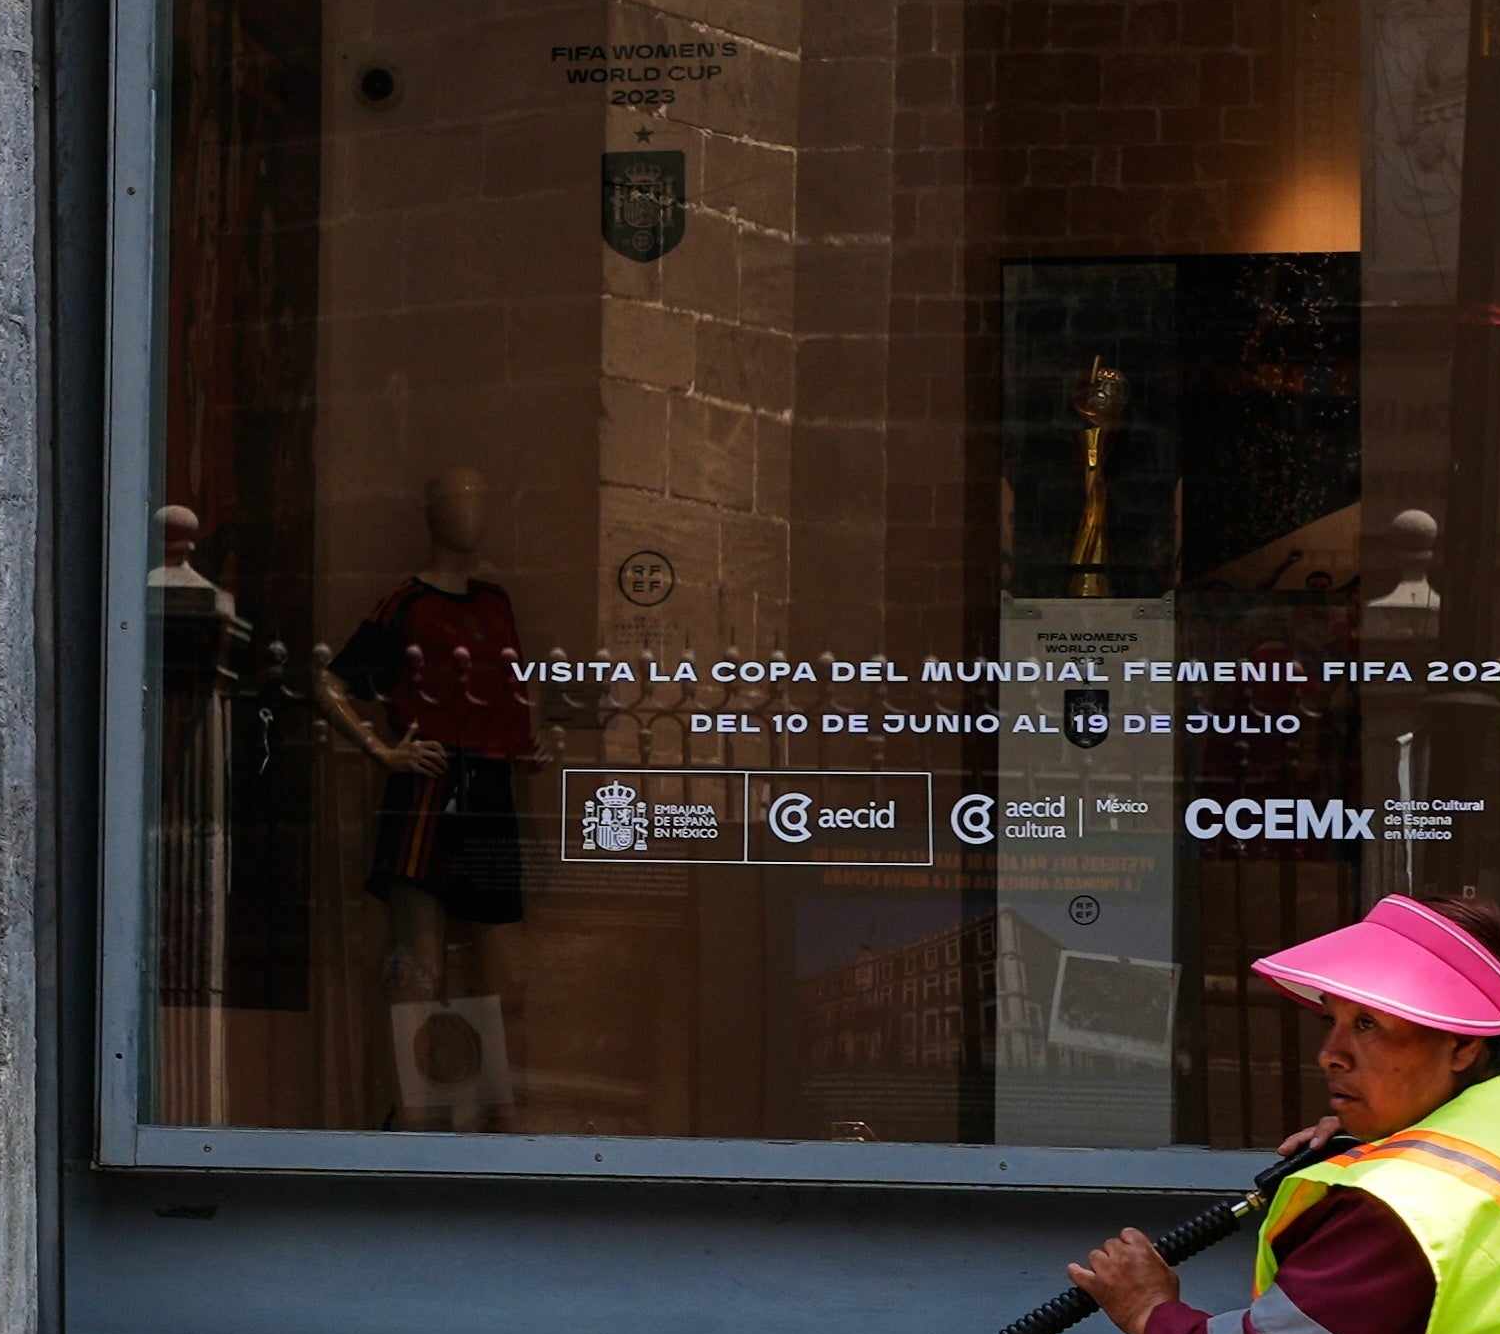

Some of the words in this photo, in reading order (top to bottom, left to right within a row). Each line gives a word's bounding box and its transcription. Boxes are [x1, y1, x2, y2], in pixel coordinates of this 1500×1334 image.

[551, 45, 608, 61] FIFA
[612, 41, 738, 60] WOMEN'S
[566, 66, 661, 84] WORLD
[668, 65, 723, 82] CUP
[610, 89, 677, 105] 2023
[1037, 633, 1068, 642] FIFA
[1069, 632, 1139, 643] WOMEN'S
[1045, 645, 1097, 654] WORLD
[1099, 644, 1130, 654] CUP
[510, 661, 636, 683] VISITA
[648, 661, 698, 683] LA
[711, 661, 818, 683] COPA
[831, 661, 909, 683] DEL
[921, 661, 1109, 683] MUNDIAL
[1123, 661, 1308, 683] FEMENIL
[1323, 661, 1413, 682] FIFA
[690, 713, 761, 734] DEL
[772, 713, 808, 734] 10
[821, 713, 870, 734] DE
[881, 713, 1000, 734] JUNIO
[1012, 714, 1060, 734] AL
[1072, 714, 1110, 734] 19
[1123, 714, 1172, 734] DE
[1185, 714, 1301, 734] JULIO
[653, 803, 716, 817] EMBAJADA
[1005, 796, 1066, 818] aecid
[1096, 797, 1149, 814] México
[1383, 799, 1430, 811] Centro
[1431, 799, 1485, 811] Cultural
[653, 815, 673, 827] DE
[817, 800, 896, 830] aecid
[1184, 798, 1376, 841] CCEMx
[1383, 814, 1402, 826] de
[653, 826, 670, 839] EN
[671, 825, 720, 840] MÉXICO
[1004, 817, 1068, 840] cultura
[1383, 829, 1402, 840] en
[1403, 827, 1453, 840] México
